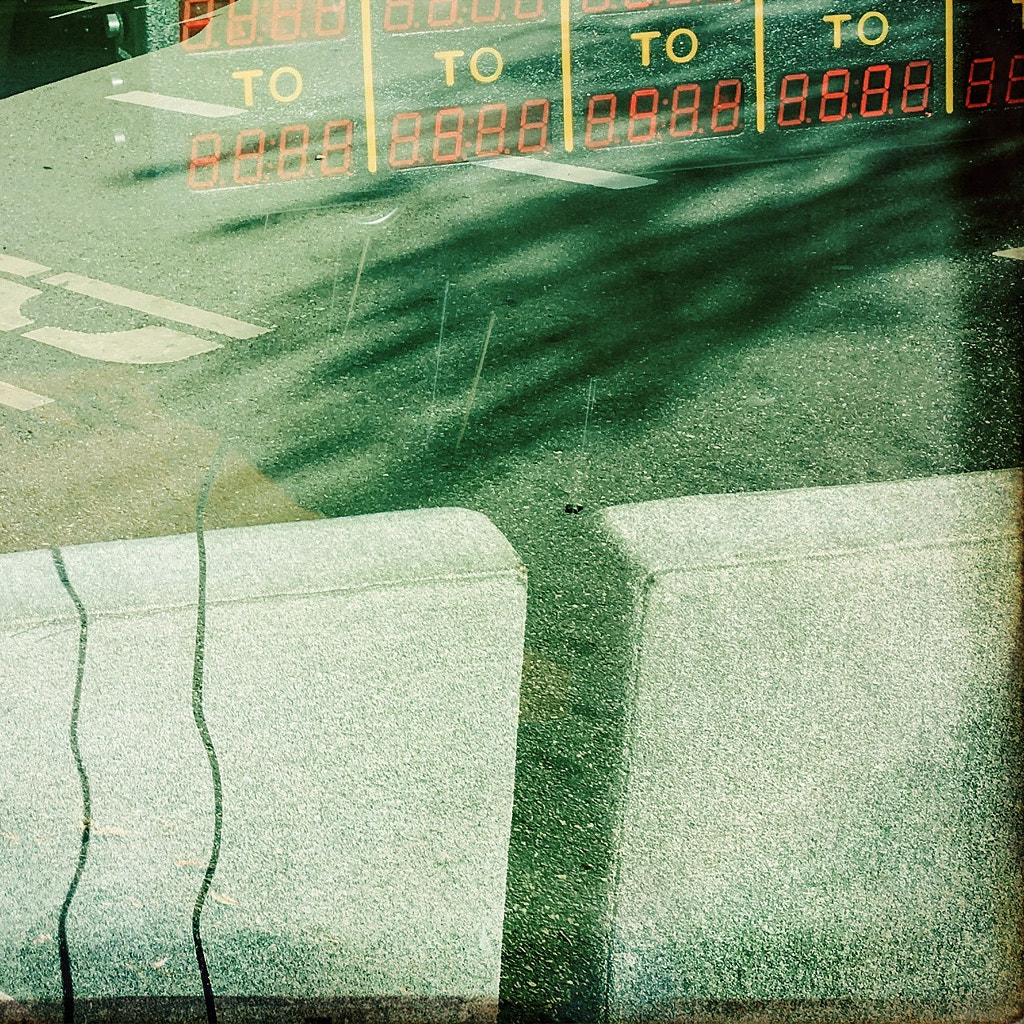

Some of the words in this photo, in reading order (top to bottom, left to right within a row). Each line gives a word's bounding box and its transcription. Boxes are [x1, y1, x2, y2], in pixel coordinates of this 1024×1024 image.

[631, 28, 698, 66] TO
[822, 11, 889, 49] TO
[232, 66, 304, 106] TO
[433, 47, 504, 87] TO
